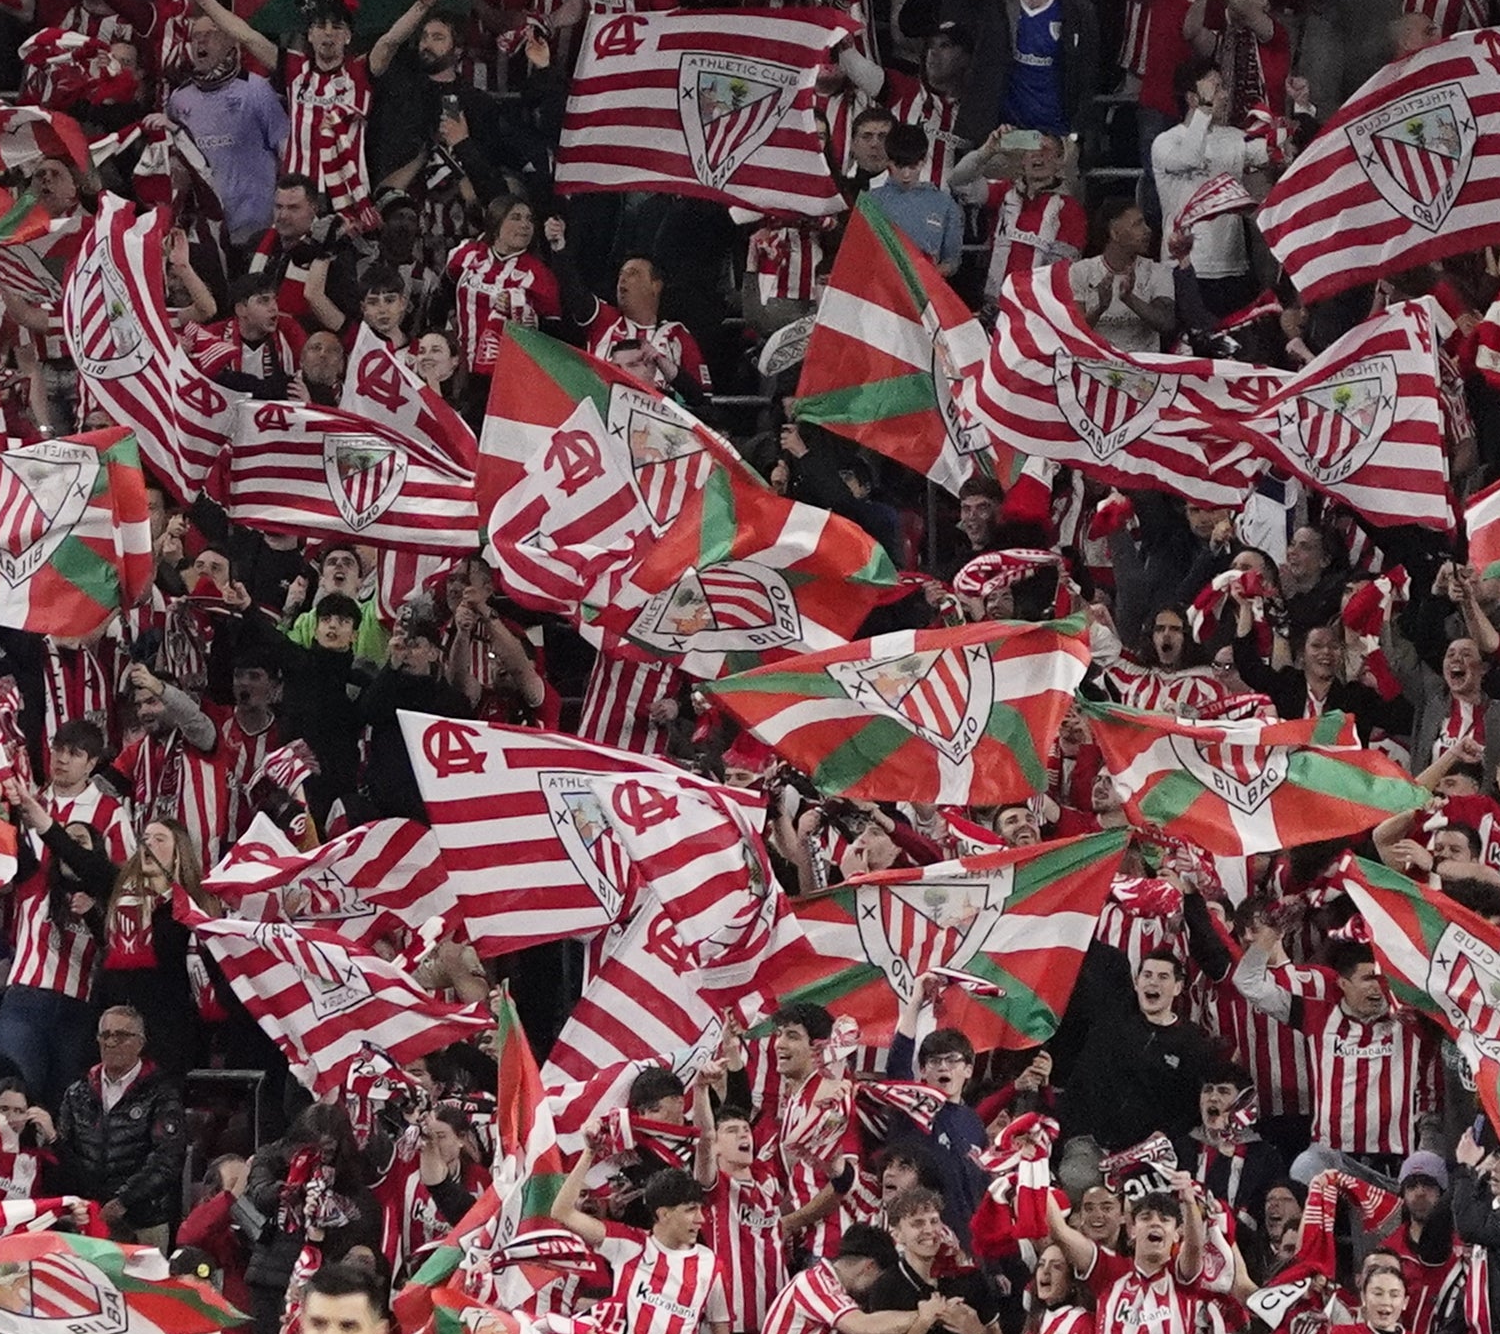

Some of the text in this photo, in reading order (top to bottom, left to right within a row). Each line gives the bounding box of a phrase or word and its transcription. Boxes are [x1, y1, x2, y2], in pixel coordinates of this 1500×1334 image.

[689, 57, 799, 87] ATHLETIC CLUB
[748, 585, 790, 647] BILBAO
[1210, 766, 1280, 808] BILBAO
[1333, 1038, 1392, 1057] Kutxabank
[742, 1206, 777, 1227] Kutxa
[636, 1281, 696, 1320] Kutxabank
[1259, 1278, 1307, 1310] CLU
